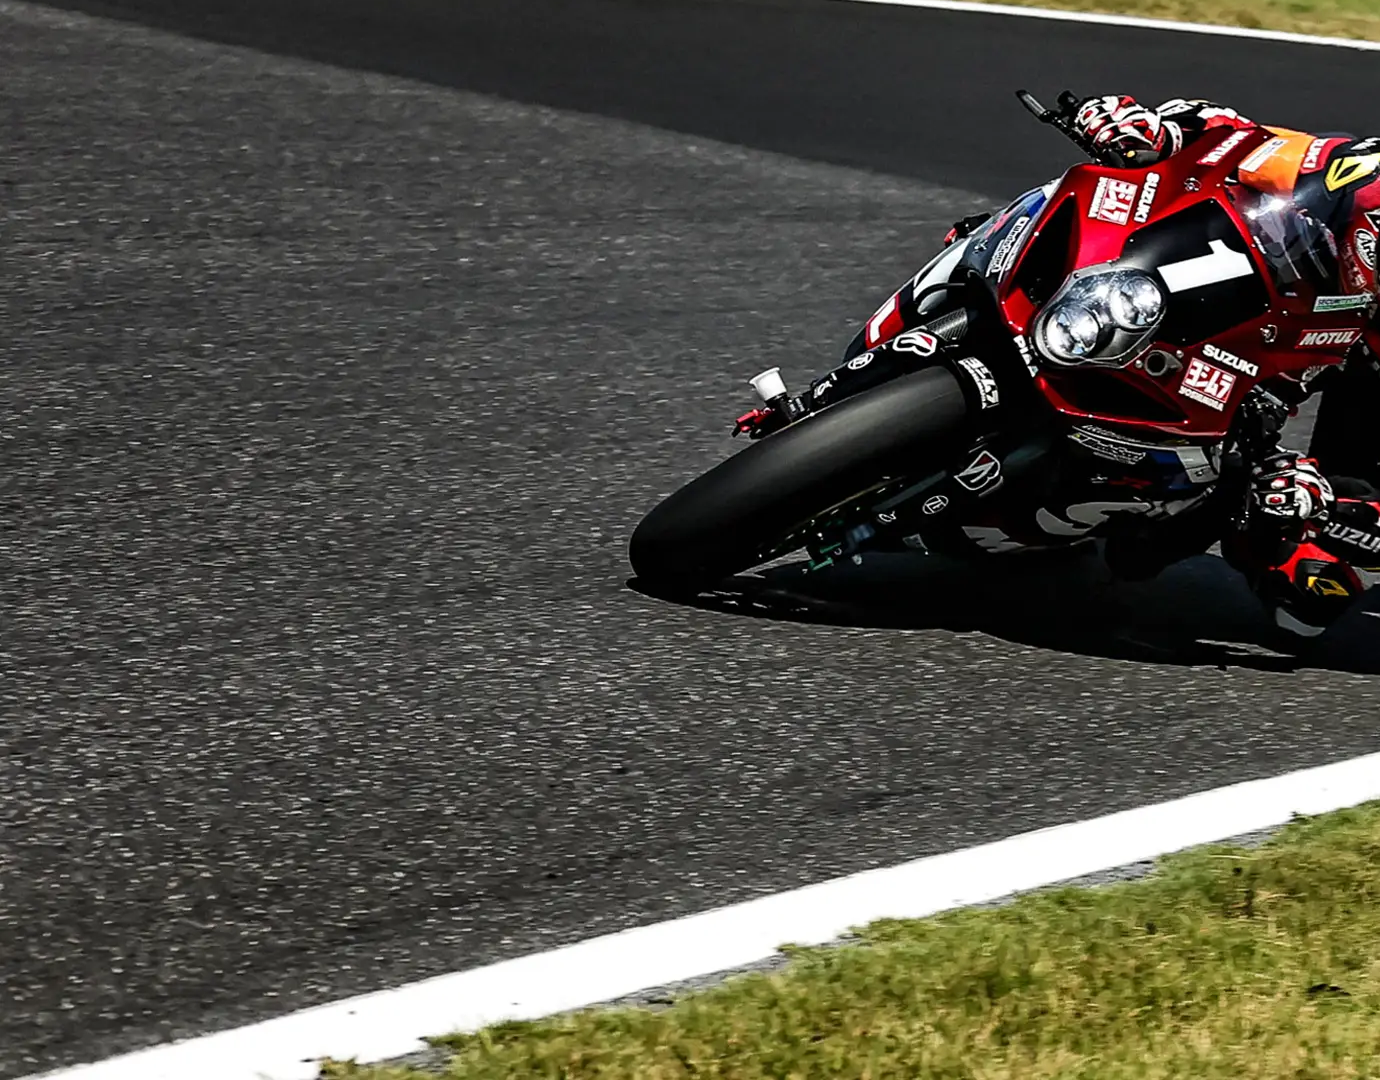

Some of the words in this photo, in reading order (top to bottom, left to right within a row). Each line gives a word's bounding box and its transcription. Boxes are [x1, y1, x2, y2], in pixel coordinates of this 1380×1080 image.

[1200, 130, 1249, 164] MOTUL
[1134, 172, 1160, 223] SUZUKI
[1157, 239, 1254, 293] 1
[1013, 334, 1039, 378] PIAA
[1299, 331, 1355, 346] MOTUL
[1183, 359, 1235, 401] ヨシムラ
[1202, 344, 1259, 377] SUZUKI
